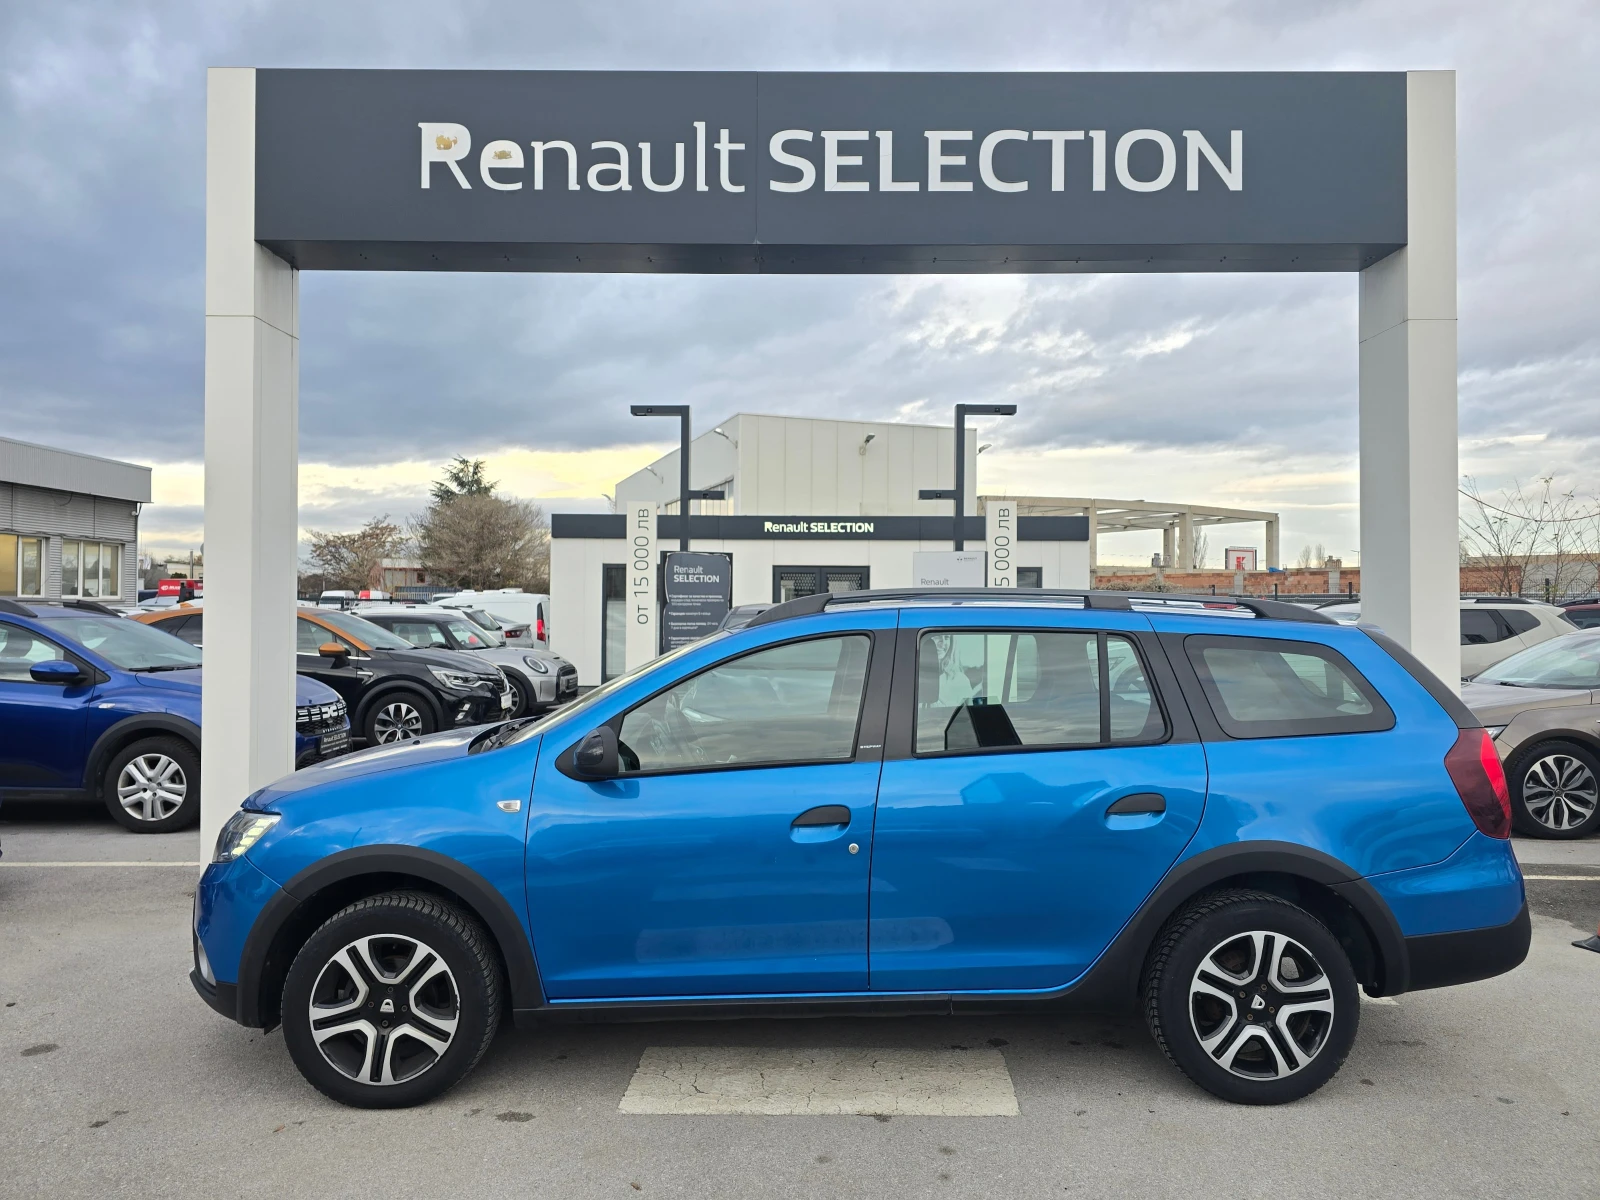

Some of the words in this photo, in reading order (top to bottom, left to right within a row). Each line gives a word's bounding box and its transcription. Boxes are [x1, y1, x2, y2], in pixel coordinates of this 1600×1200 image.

[417, 121, 746, 193] Renault
[768, 128, 1244, 193] SELECTION
[638, 508, 649, 531] лв
[763, 521, 809, 533] Renault
[810, 522, 874, 533] SELECTION
[998, 508, 1010, 531] лв
[633, 535, 649, 571] 000
[994, 535, 1010, 571] 000
[673, 565, 704, 574] Renault
[673, 574, 720, 583] SELECTION
[634, 576, 649, 598] 15
[920, 578, 950, 586] Renault
